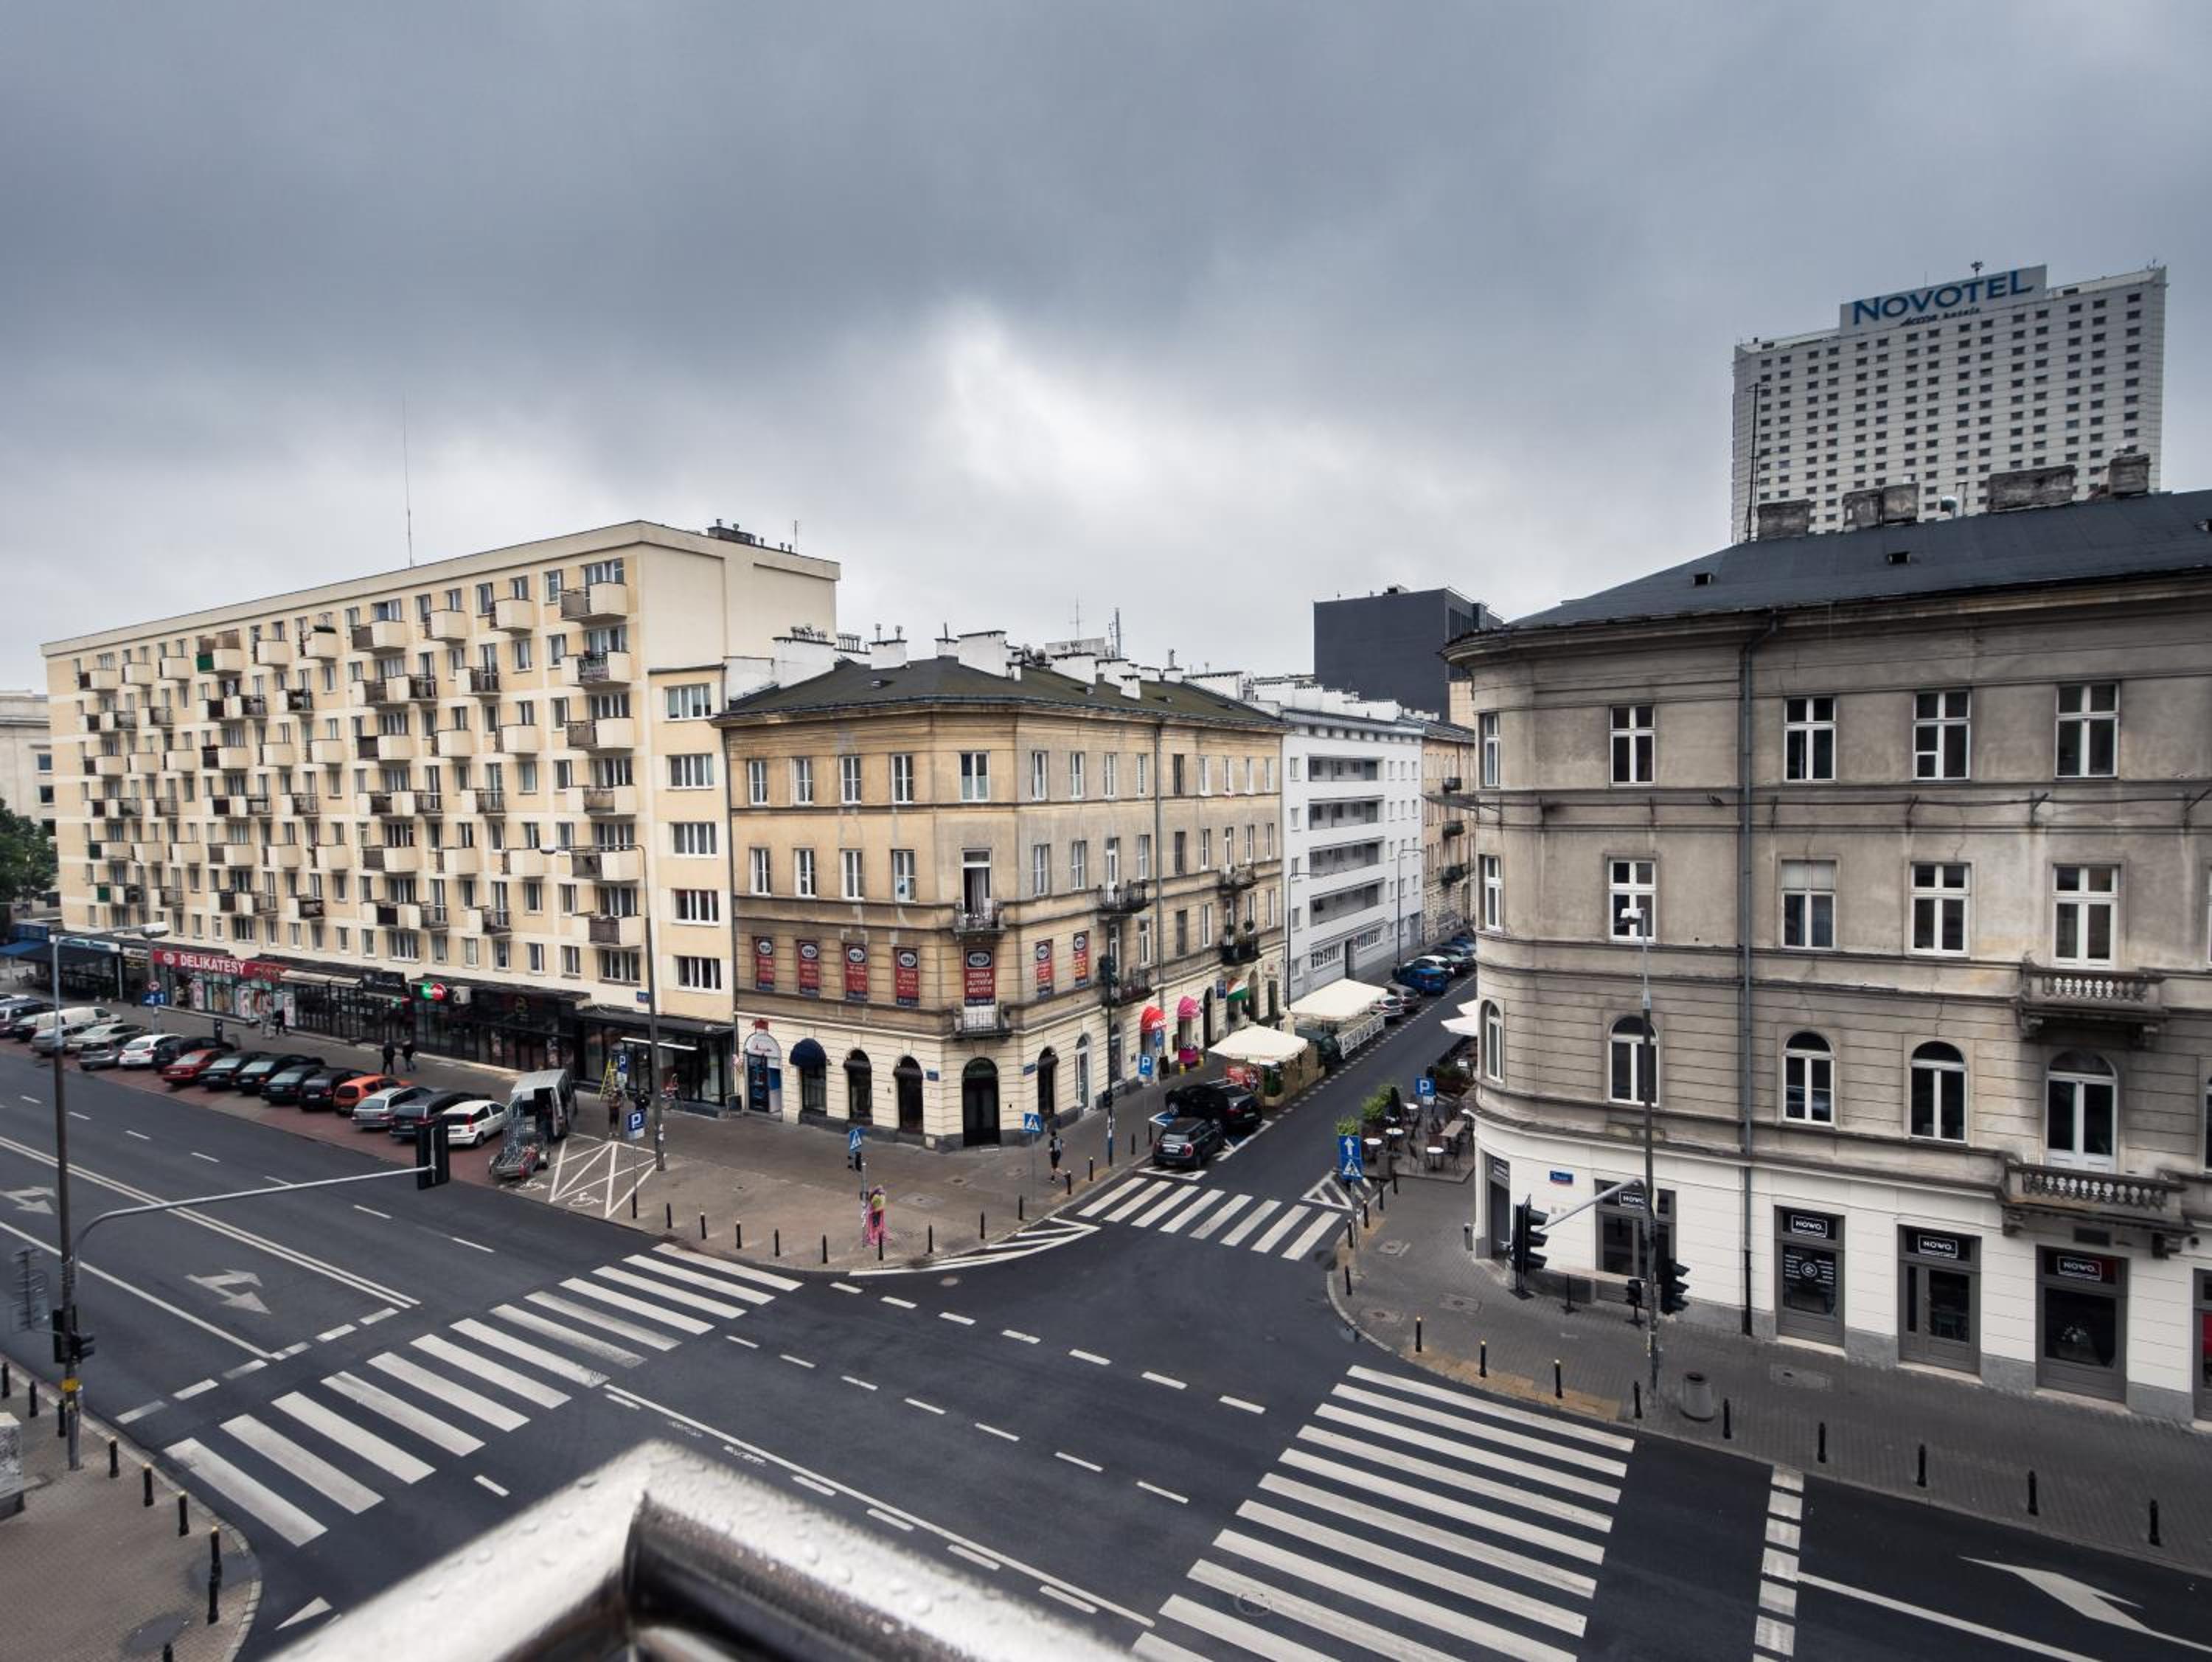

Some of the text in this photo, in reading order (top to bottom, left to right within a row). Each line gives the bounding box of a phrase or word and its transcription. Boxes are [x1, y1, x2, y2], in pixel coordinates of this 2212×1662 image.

[1852, 270, 2034, 325] NOVOTEL
[180, 953, 246, 975] DELIKATESY
[619, 1055, 626, 1066] P
[1142, 1057, 1151, 1068] P
[1419, 1079, 1430, 1093] P
[632, 1113, 642, 1129] P
